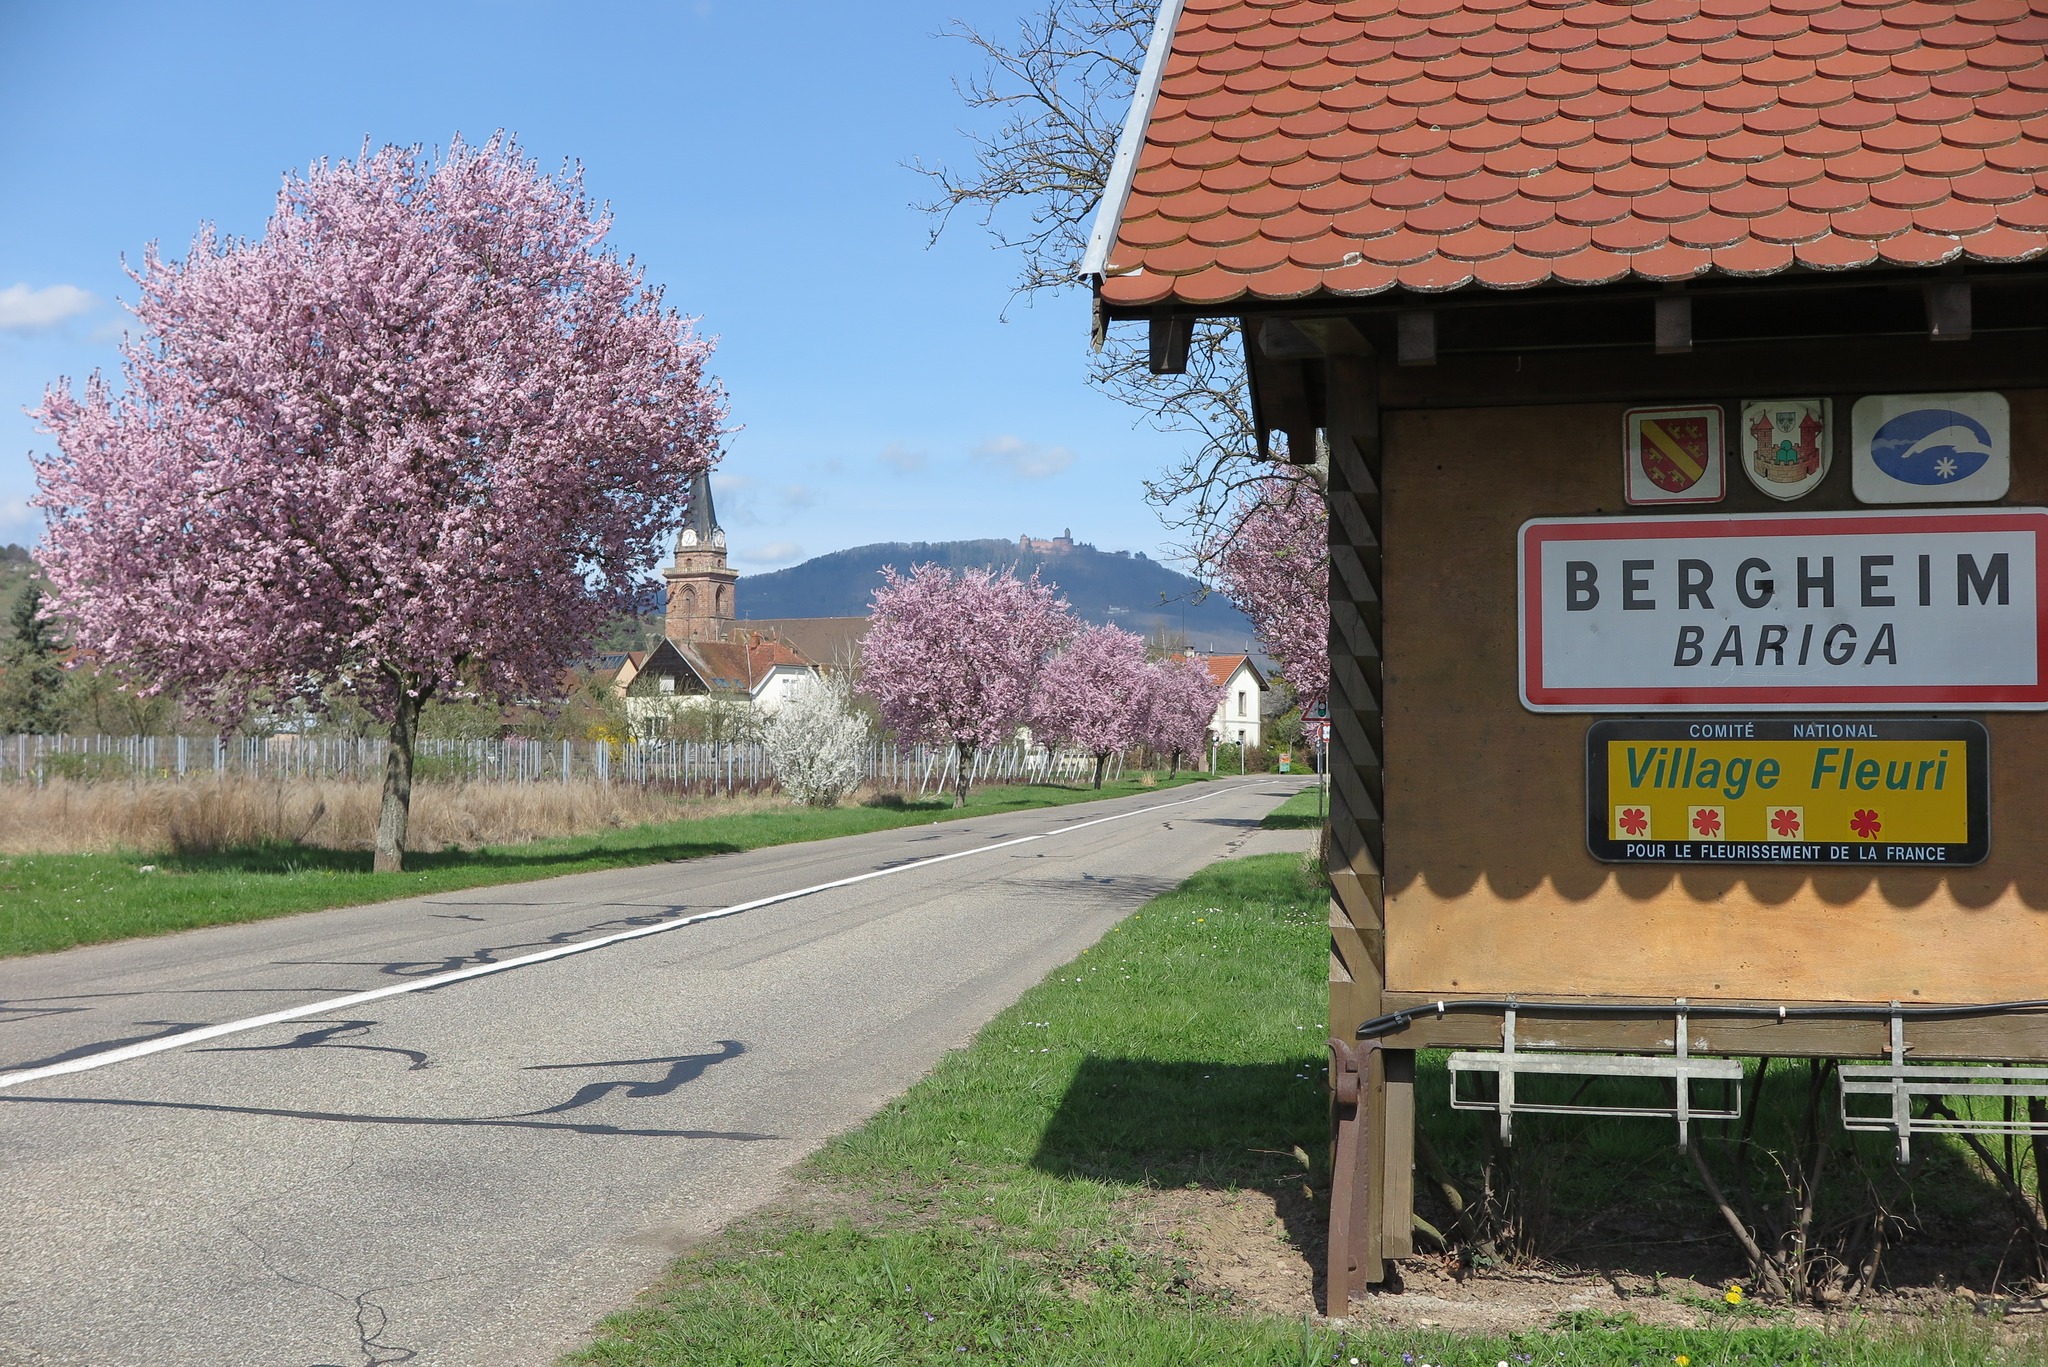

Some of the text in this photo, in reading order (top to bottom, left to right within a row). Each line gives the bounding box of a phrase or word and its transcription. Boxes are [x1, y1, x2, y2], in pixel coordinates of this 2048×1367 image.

[1566, 553, 2009, 611] BERGHEIM
[1673, 623, 1898, 667] BARIGA
[1689, 722, 1878, 738] COMITÉ NATIONAL
[1627, 747, 1949, 800] Village Fleuri
[1627, 844, 1946, 861] POUR LE FLEURISSEMENT DE LA FRANCE
